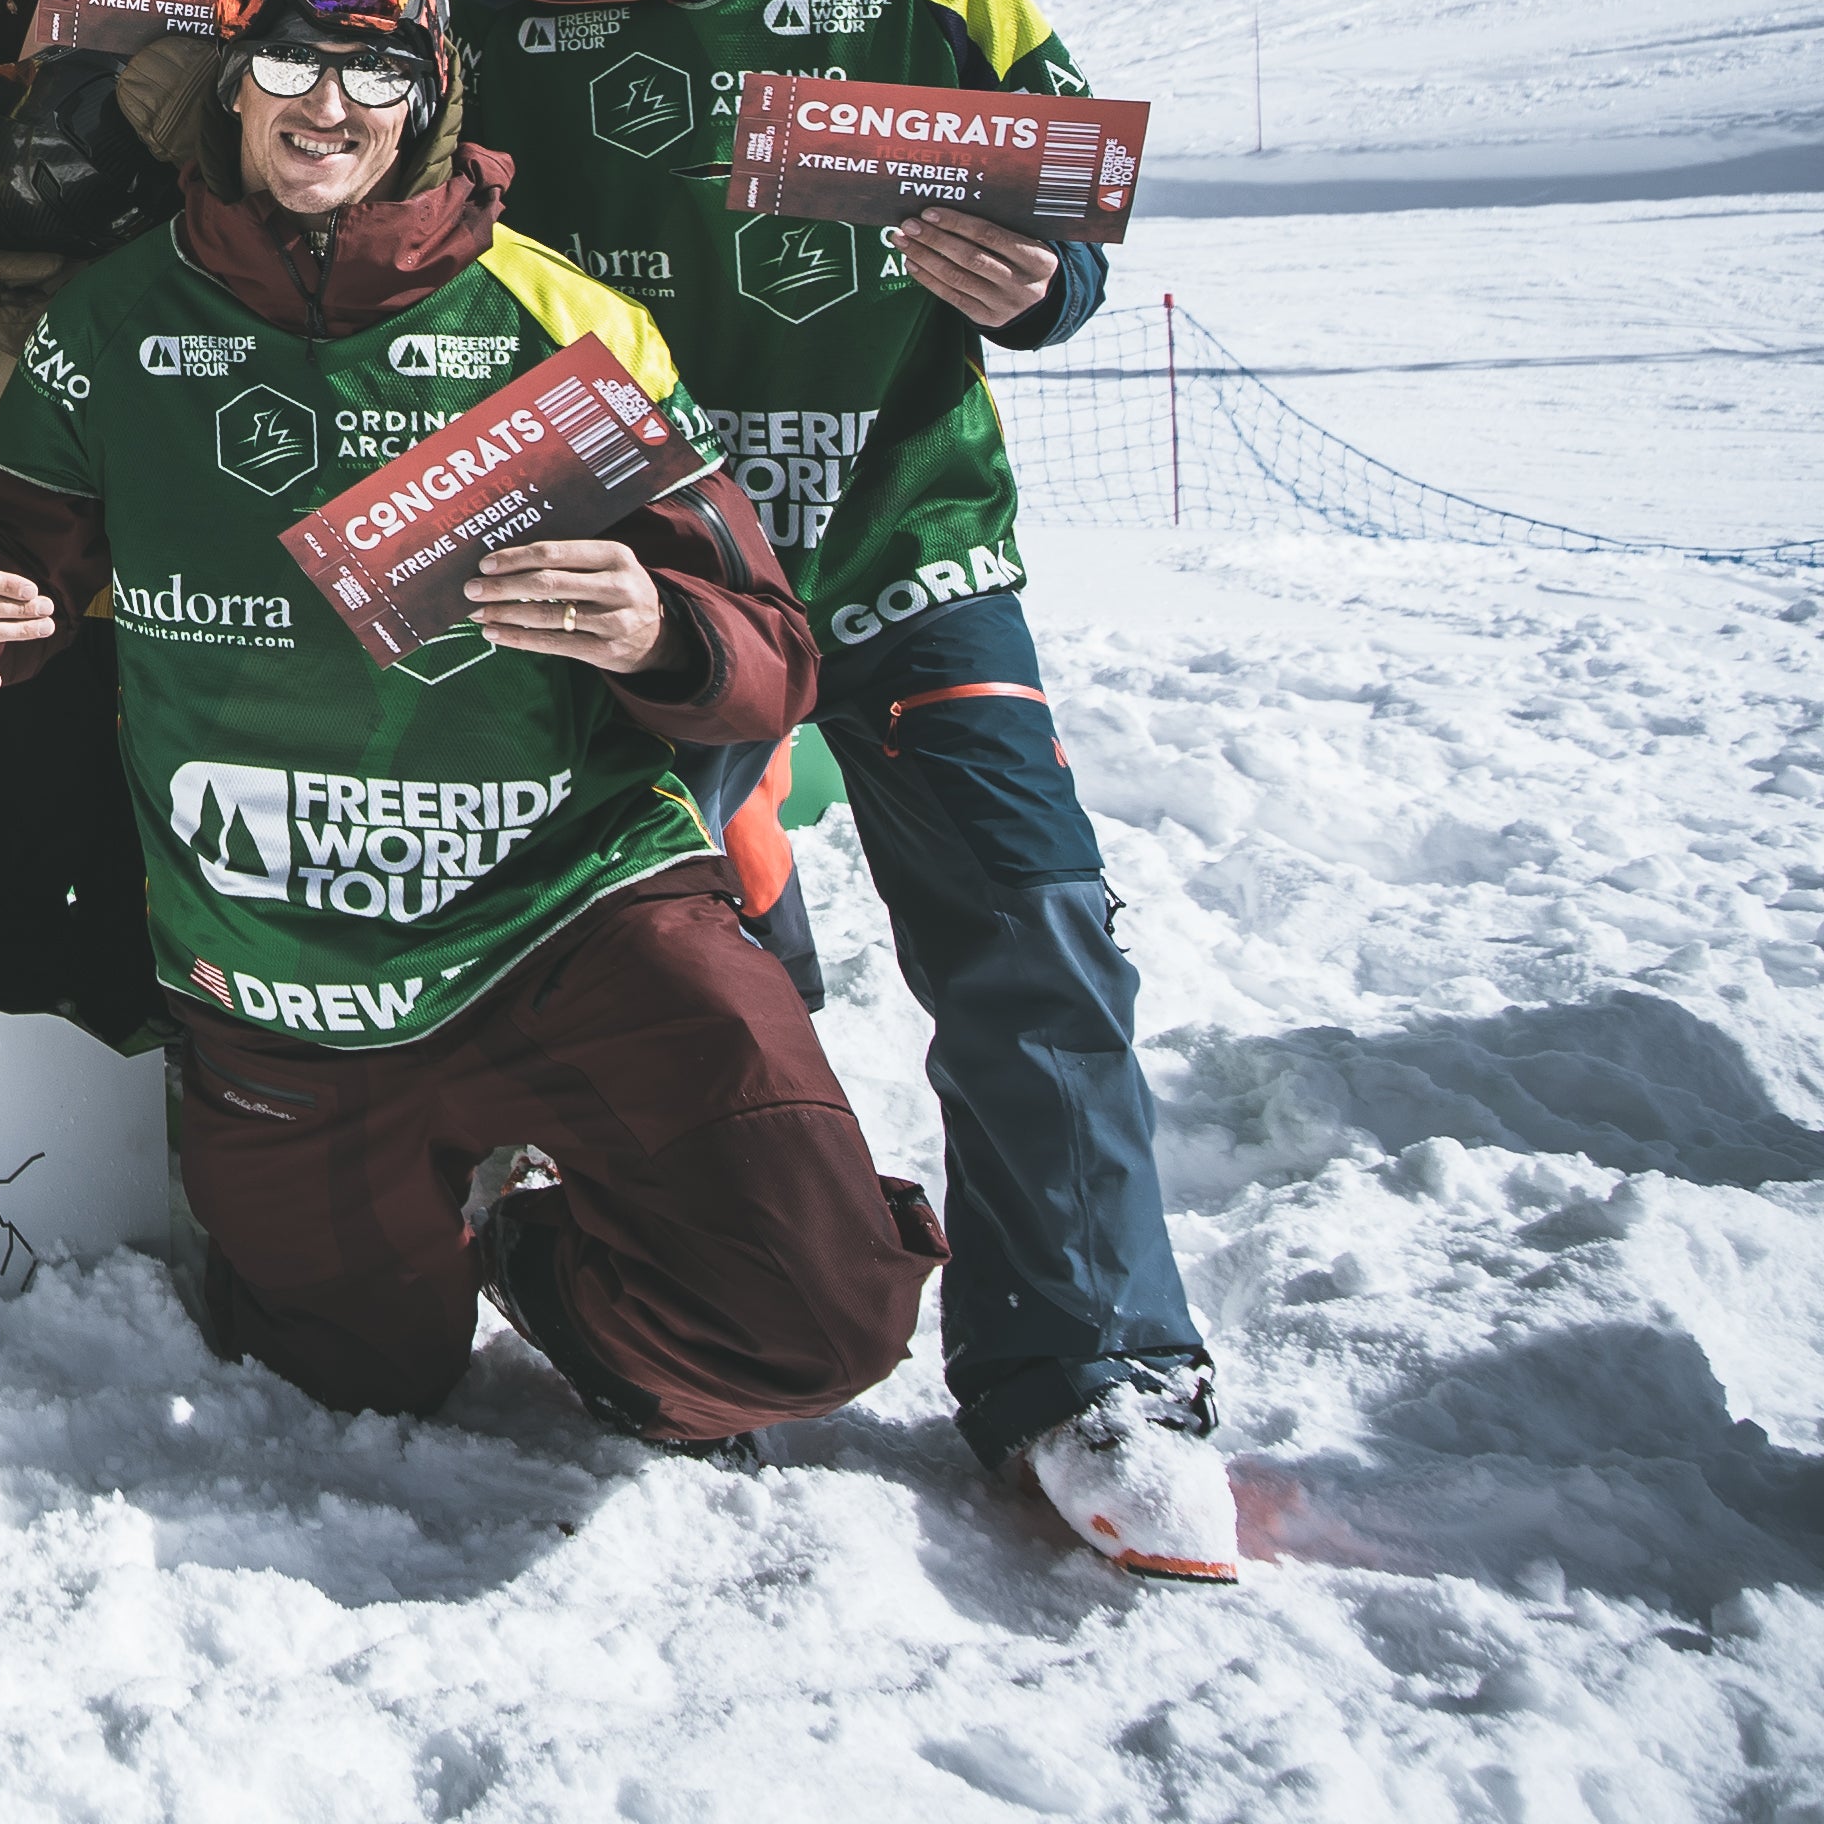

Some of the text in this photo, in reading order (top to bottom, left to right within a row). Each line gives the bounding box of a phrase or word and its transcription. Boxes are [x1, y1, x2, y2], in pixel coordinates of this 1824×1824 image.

[556, 7, 630, 31] FREERIDE
[811, 3, 884, 23] WORLD
[558, 21, 622, 40] WORLD
[812, 18, 866, 34] TOUR
[558, 36, 605, 52] TOUR
[796, 100, 1040, 150] CONGRATS
[798, 152, 969, 183] XTREME VERBIER
[1099, 138, 1119, 184] FREERIDE
[1109, 145, 1129, 186] WORLD
[1119, 156, 1137, 186] TOUR
[899, 182, 966, 201] FWT20
[181, 336, 256, 353] FREERIDE
[436, 334, 521, 354] FREERIDE
[182, 349, 247, 365] WORLD
[438, 349, 512, 367] WORLD
[182, 362, 230, 377] TOUR
[438, 363, 492, 380] TOUR
[344, 408, 547, 551] CONGRATS
[385, 491, 529, 587] XTREME VERBIER
[481, 507, 542, 552] FWT20
[112, 573, 294, 629] Andorra
[294, 768, 572, 832] FREERIDE
[233, 971, 424, 1032] DREW
